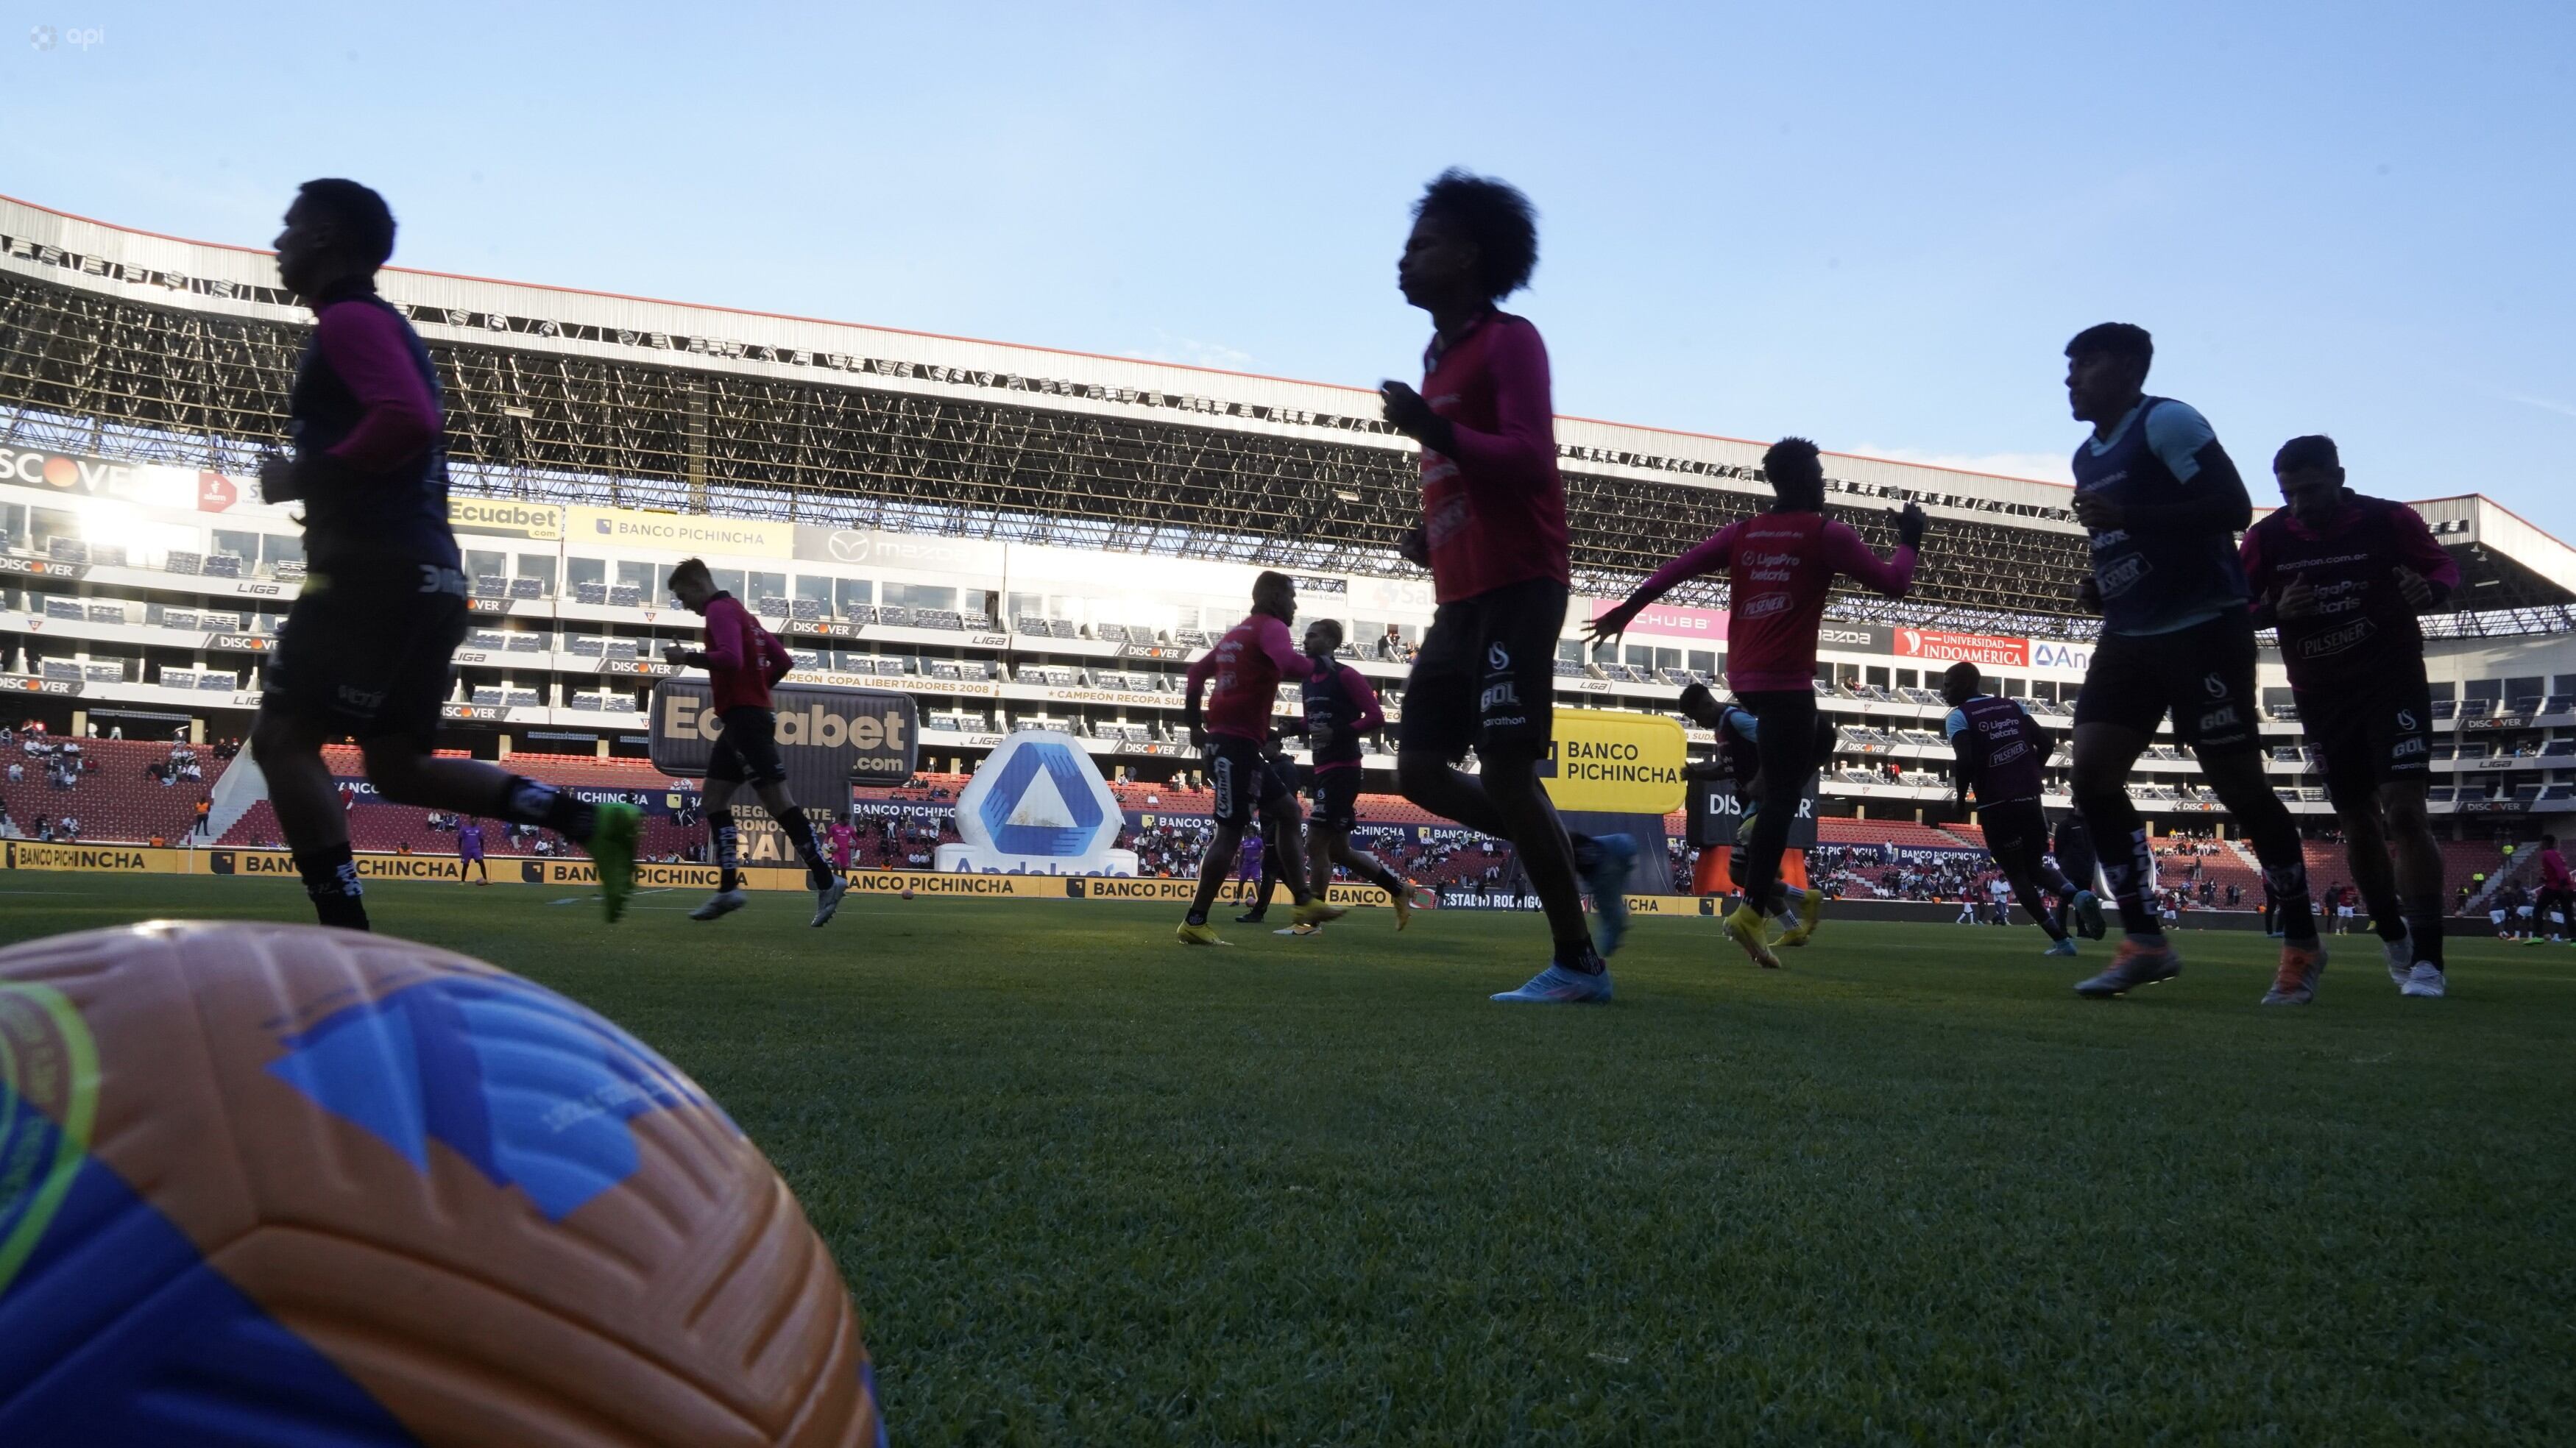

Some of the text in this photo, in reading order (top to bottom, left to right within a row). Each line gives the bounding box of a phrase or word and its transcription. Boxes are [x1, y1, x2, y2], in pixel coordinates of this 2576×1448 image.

[448, 502, 556, 528] Ecuabet
[620, 522, 765, 545] BANCO PICHINCHA
[0, 557, 73, 576] DISCOVER
[2313, 581, 2368, 600] igaPro
[2318, 597, 2361, 614] tcris
[793, 622, 850, 635] DISCOVER
[1635, 614, 1707, 629] CHUBB
[221, 636, 278, 650] DISCOVE
[1943, 635, 2005, 649] UNIVERSIDAD
[2304, 623, 2365, 655] PILSENER
[1128, 646, 1179, 659] DISCOVER
[1924, 644, 2022, 666] INDOAMÉRICA
[612, 661, 671, 675] DISCOVER
[787, 672, 988, 694] PEÓN COPA LIBERTADORES 2008
[1058, 691, 1114, 701] CAMPEÓN
[1117, 696, 1161, 705] RECOPA
[1480, 681, 1521, 711] GOL
[442, 707, 496, 719] ISCOVER
[664, 695, 905, 750] Ecabet
[1990, 718, 2020, 729] LigaPro
[2468, 718, 2521, 728] DISCOVER
[1990, 728, 2019, 739] betcris
[1125, 743, 1175, 756] DISCOVER
[1568, 741, 1638, 761] BANCO
[1848, 742, 1886, 753] DISCOVER
[1993, 743, 2025, 764] PILSENER
[2391, 736, 2427, 759] GOL
[853, 757, 904, 771] .com
[1568, 763, 1677, 784] PICHINCHA
[577, 792, 648, 806] ICHINCA
[2467, 801, 2520, 811] DISCOVER
[853, 803, 899, 815] BANCO
[1159, 817, 1201, 828] BANCO
[1351, 826, 1404, 837] CHINCHA
[21, 847, 145, 869] BANCO PICHINCHA
[1901, 850, 1932, 859] BANCO
[247, 856, 294, 873] BAN
[356, 859, 459, 878] CHINCHA
[554, 865, 598, 881] BAN
[634, 869, 749, 886] PICHINCA
[849, 875, 1013, 893] ANCO PICHINCHA
[1094, 882, 1156, 898] BANCO
[1329, 890, 1387, 904] BANCO
[1493, 895, 1542, 909] RODIGO
